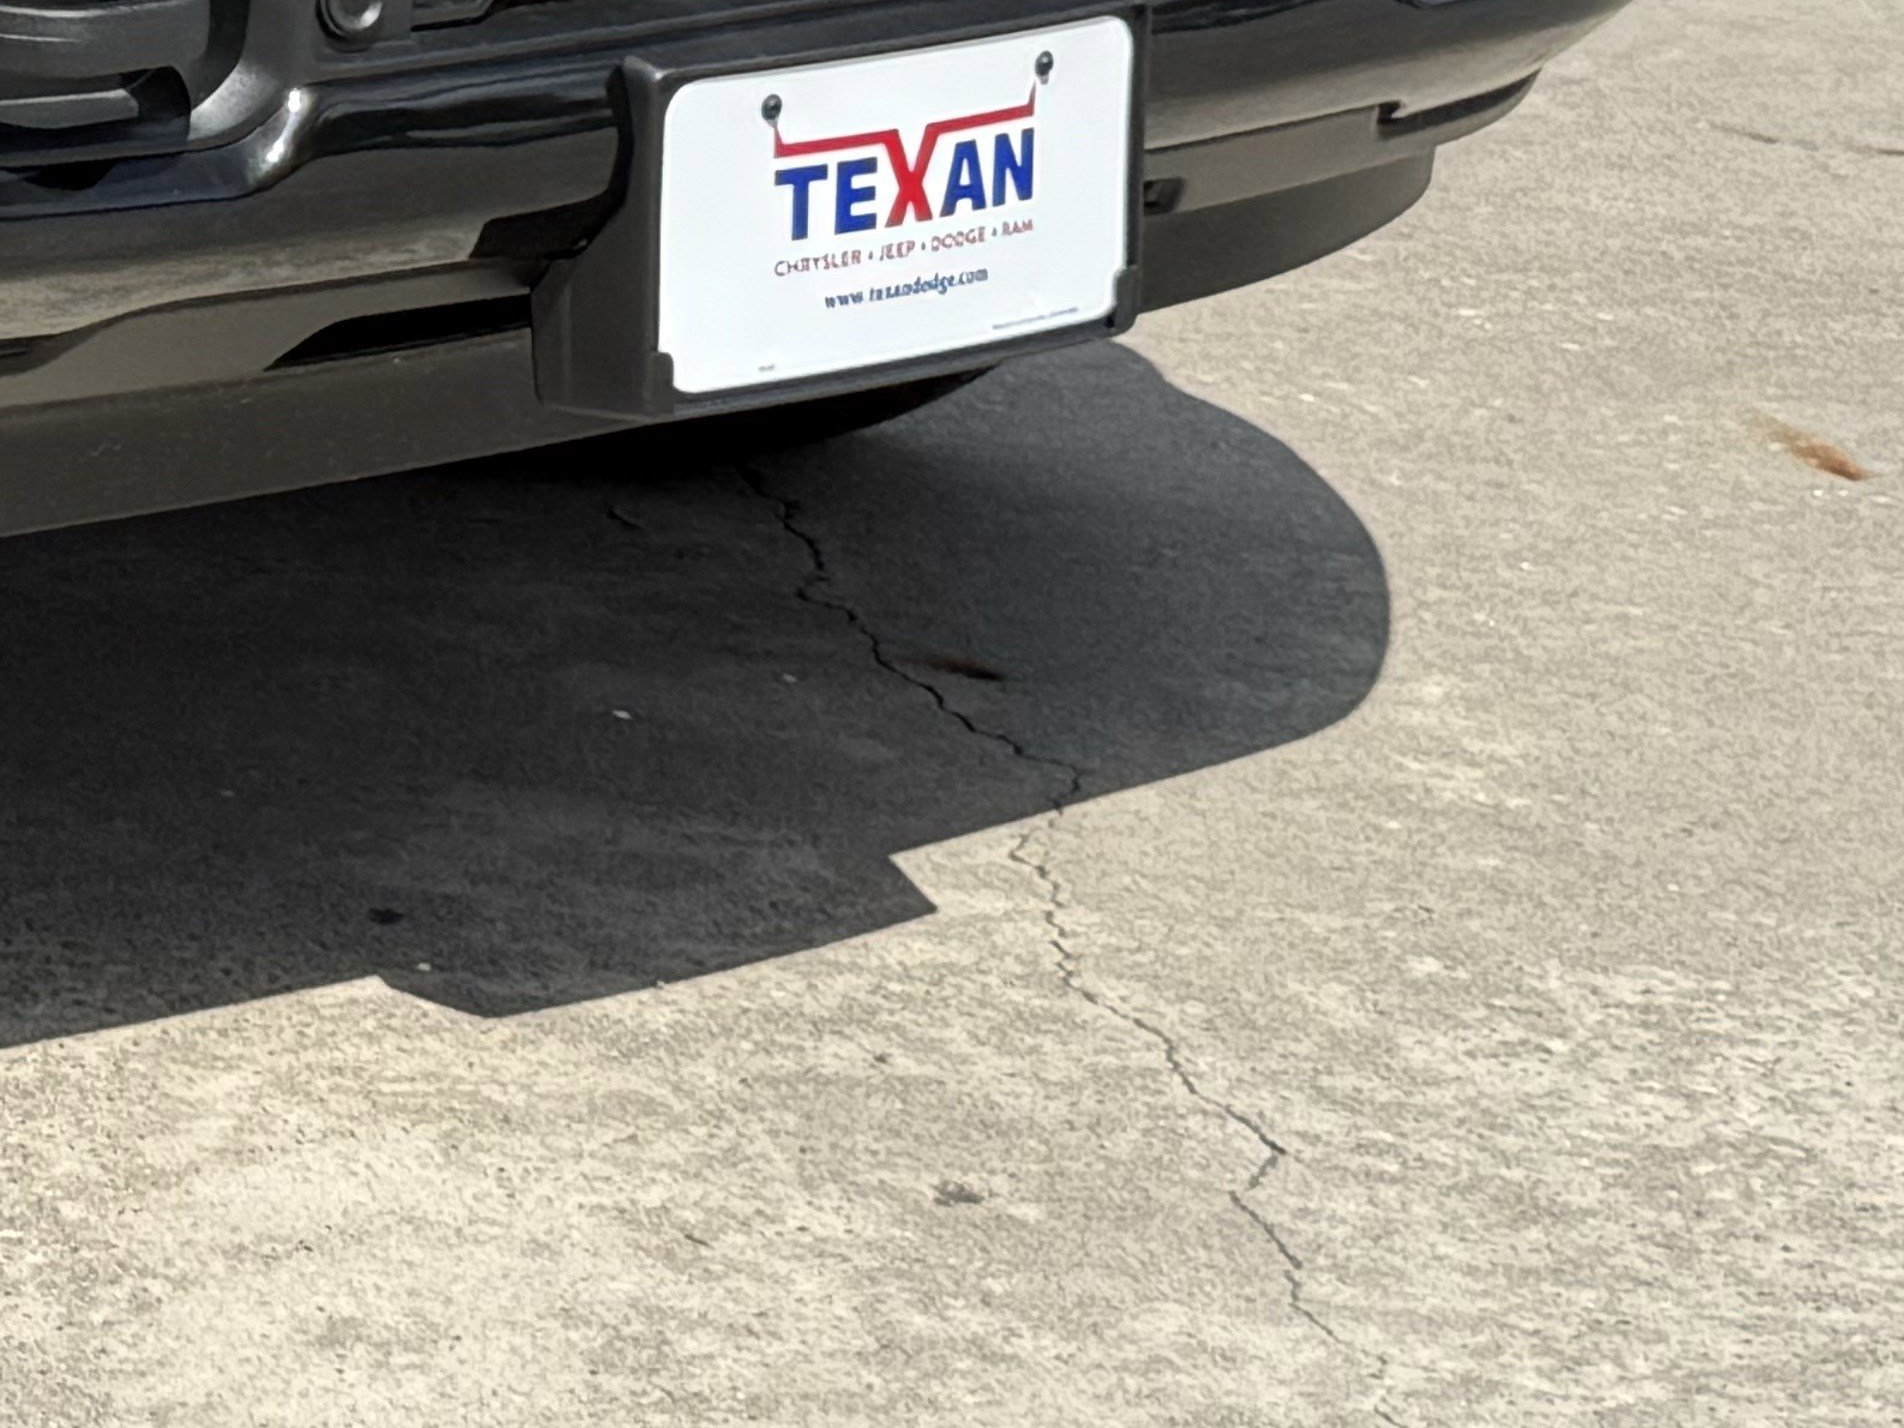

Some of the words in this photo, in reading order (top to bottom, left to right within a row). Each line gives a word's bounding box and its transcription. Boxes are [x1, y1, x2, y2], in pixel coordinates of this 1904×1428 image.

[774, 127, 1035, 242] TEXAN
[774, 249, 862, 277] CHRYSLER
[879, 240, 916, 262] JEEP
[931, 225, 986, 253] DODGE
[1002, 218, 1034, 237] RAM
